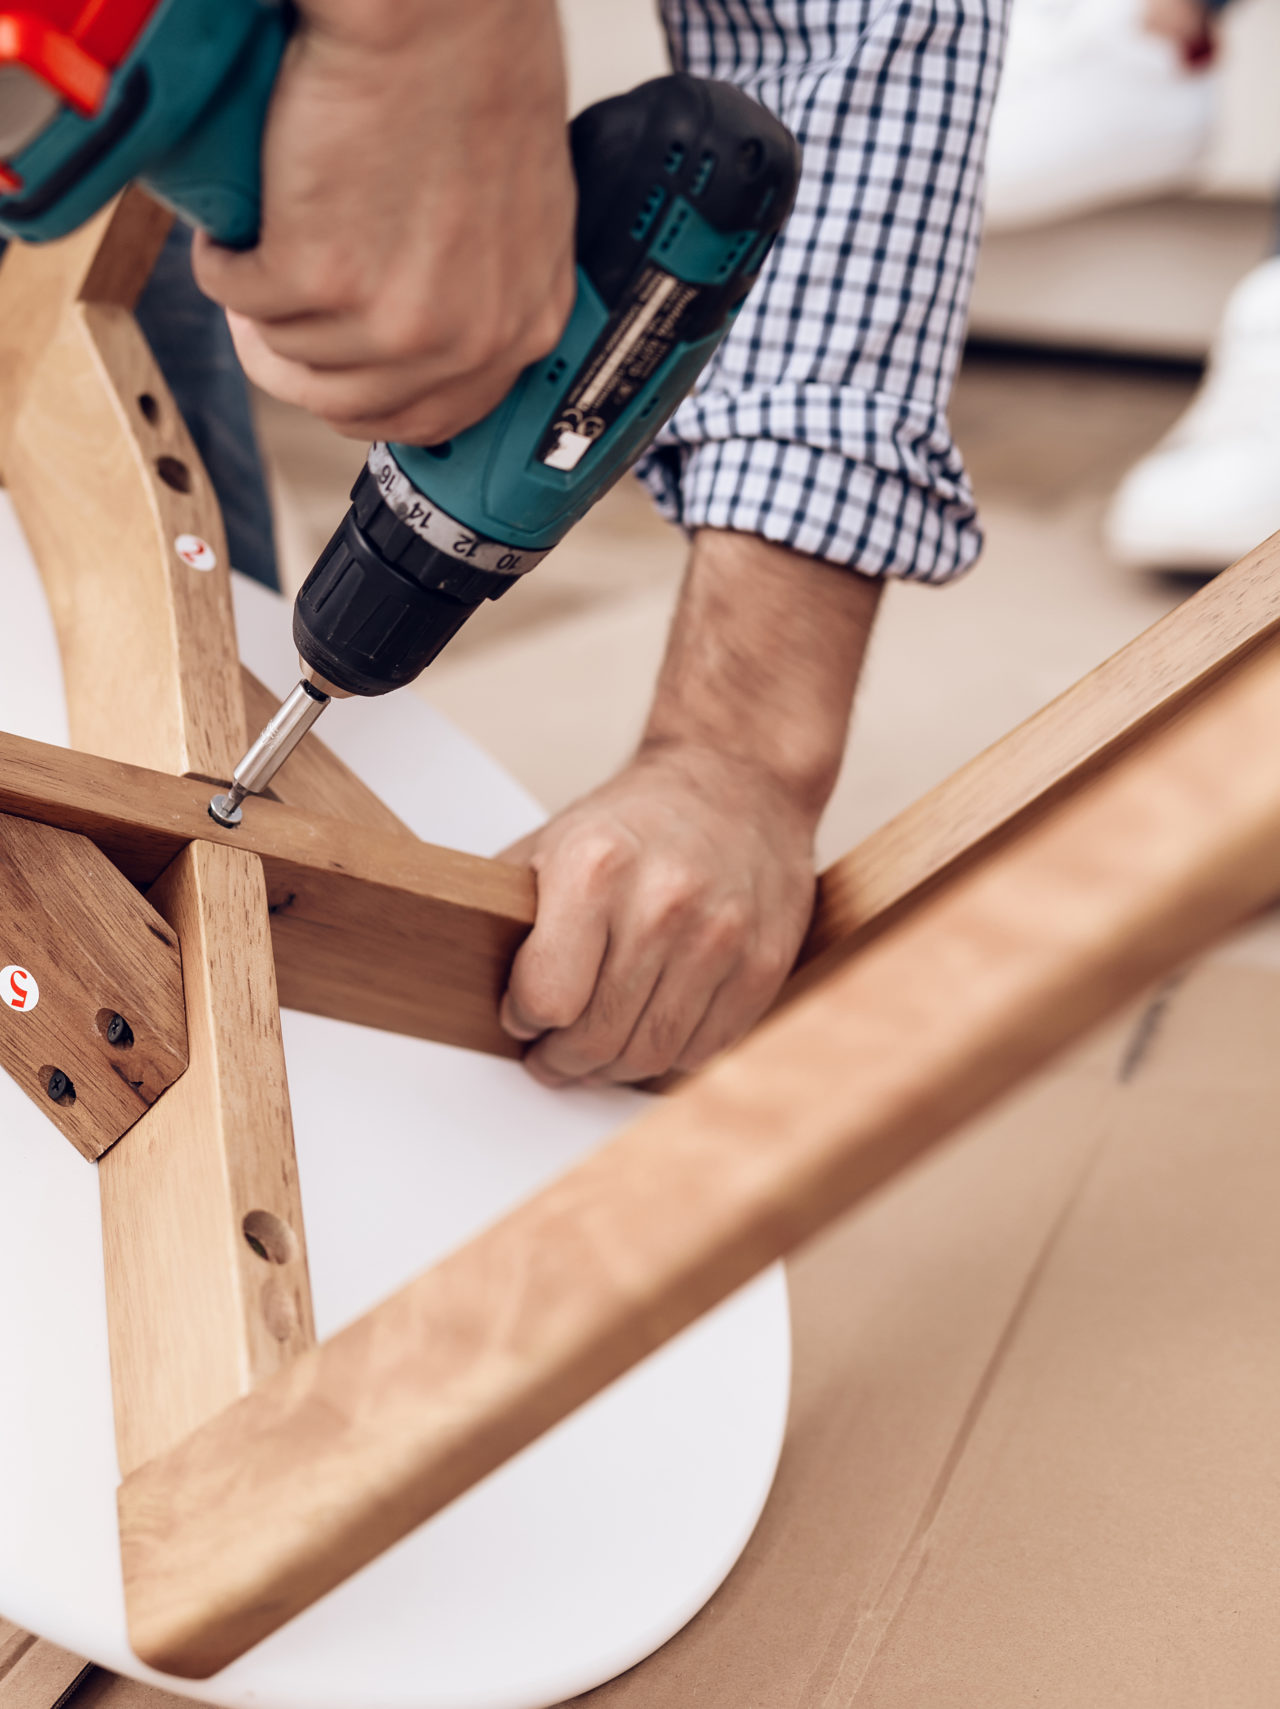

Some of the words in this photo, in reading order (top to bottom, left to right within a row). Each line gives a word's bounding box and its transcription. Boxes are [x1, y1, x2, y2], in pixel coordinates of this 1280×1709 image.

[379, 465, 396, 492] 16
[408, 502, 433, 529] 14
[181, 541, 205, 563] 2
[452, 533, 481, 558] 12
[497, 553, 522, 570] 10
[9, 970, 28, 1008] 5
